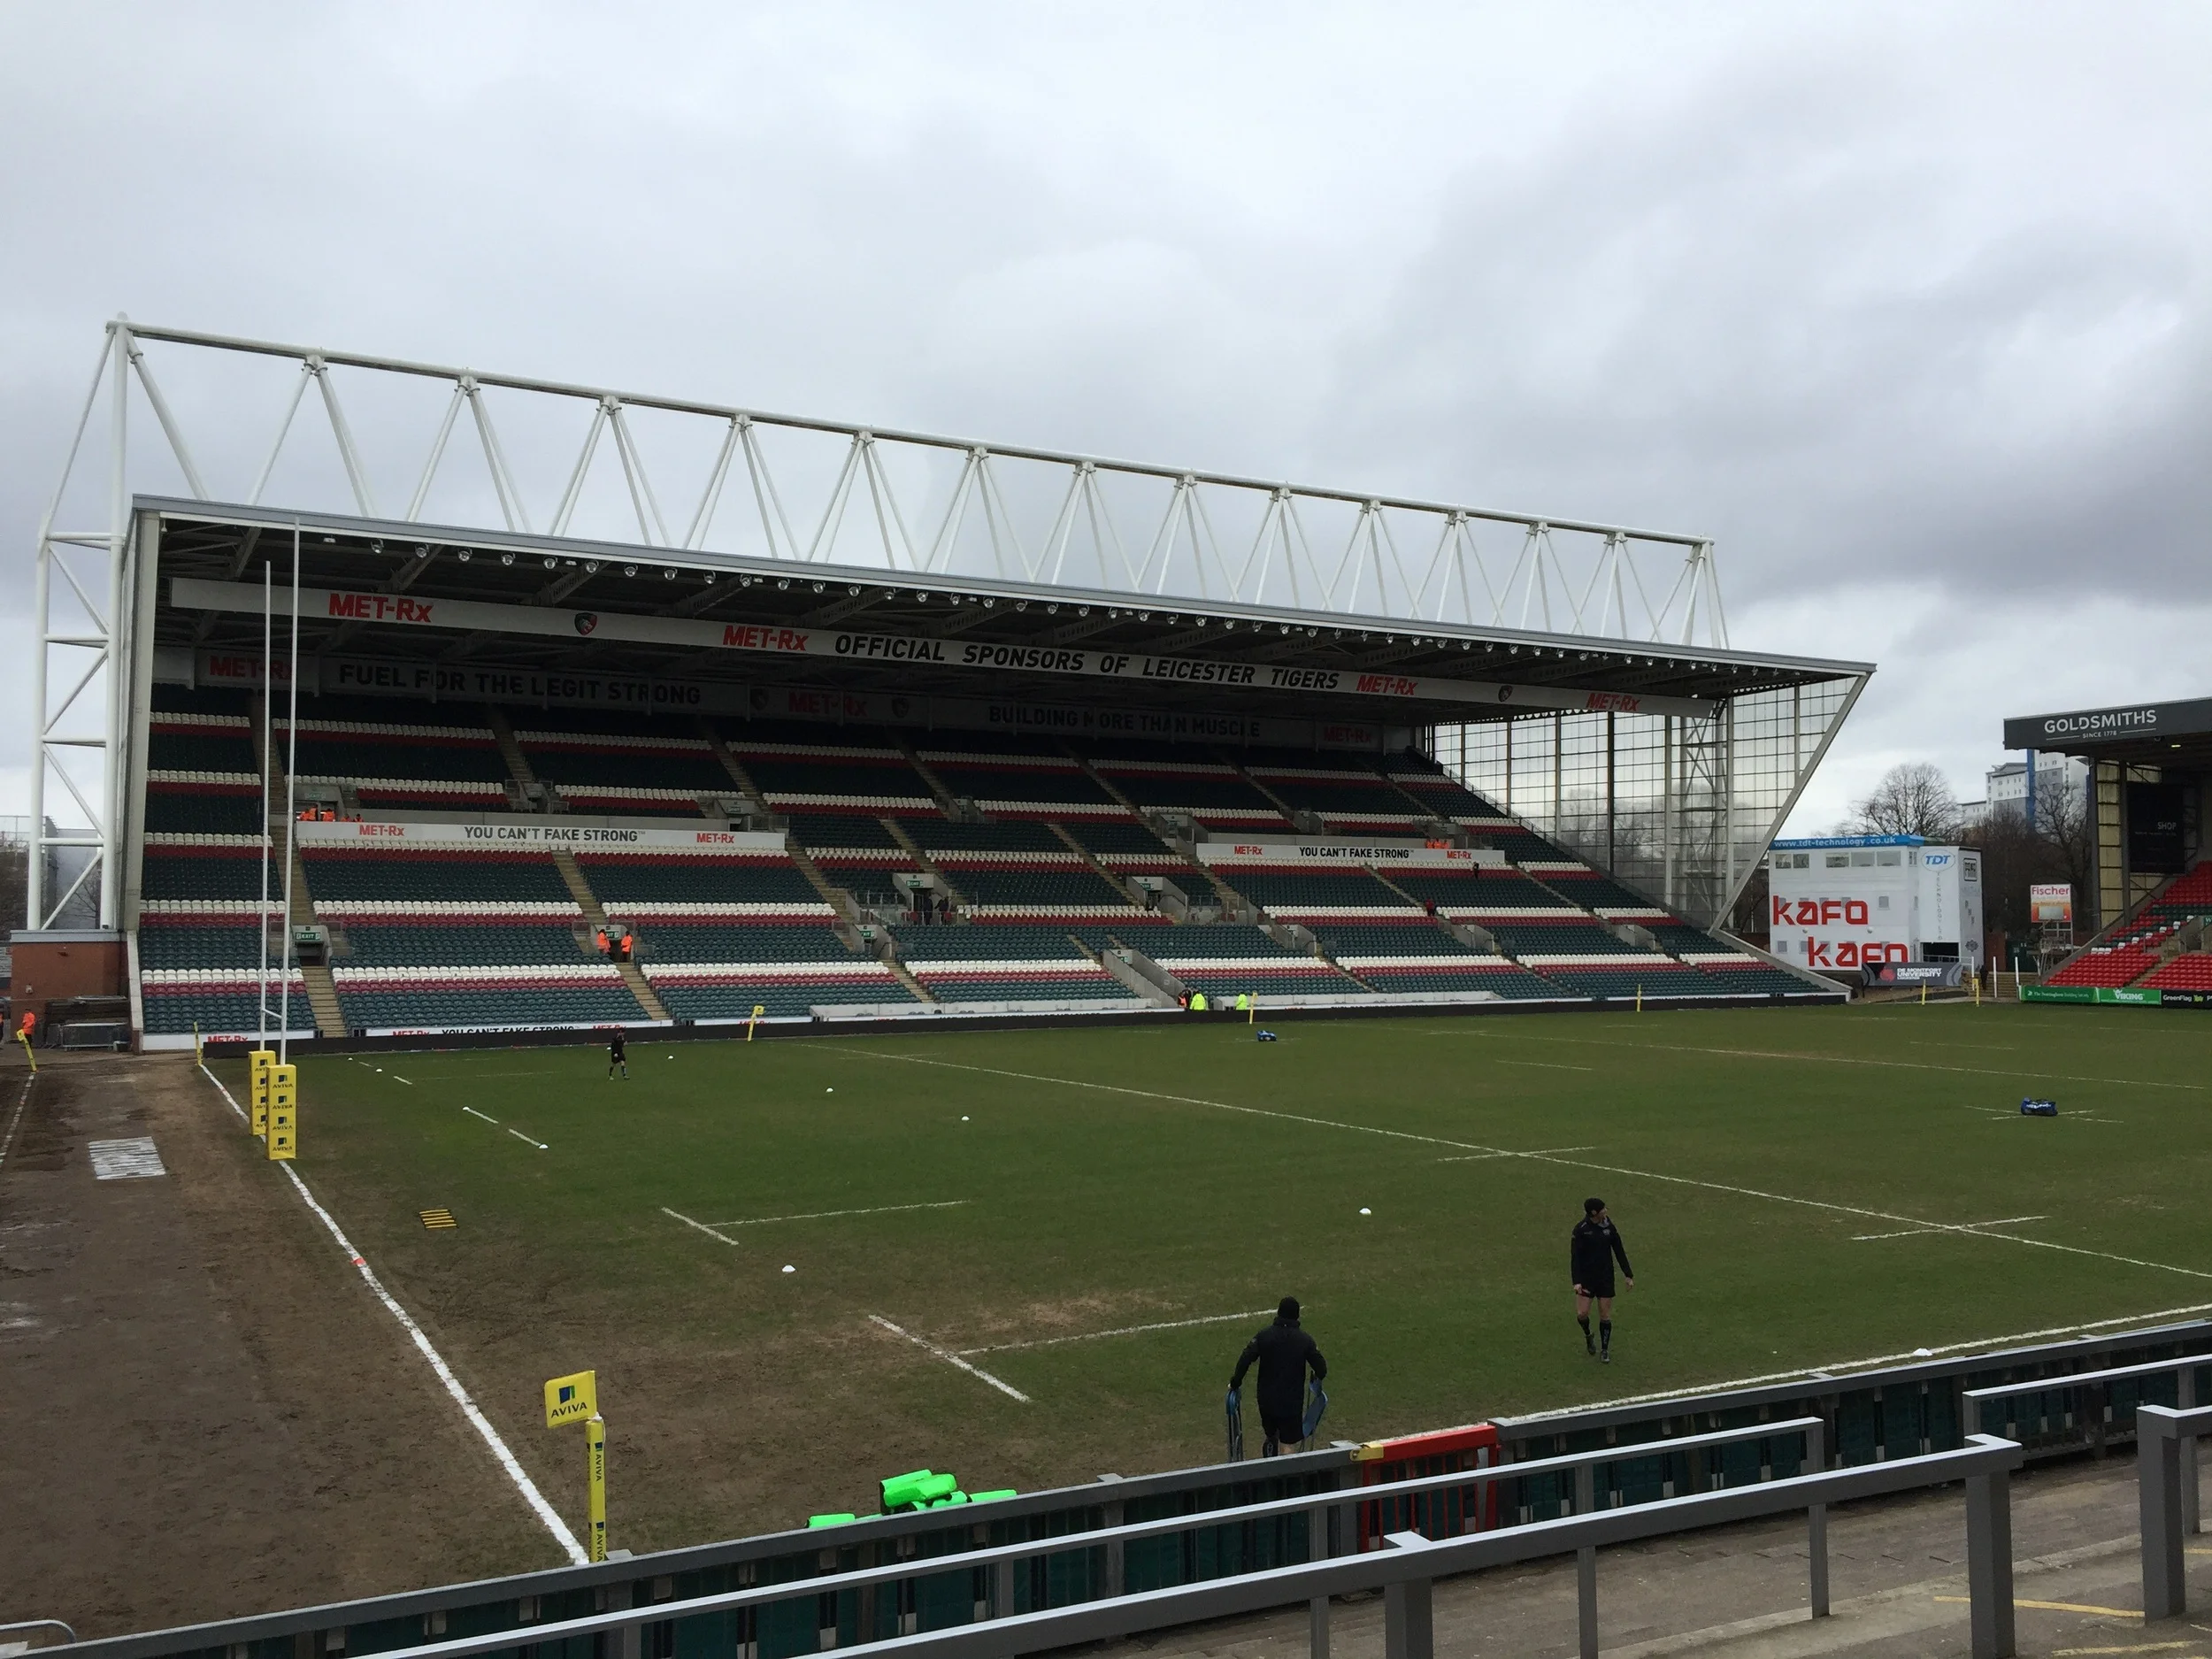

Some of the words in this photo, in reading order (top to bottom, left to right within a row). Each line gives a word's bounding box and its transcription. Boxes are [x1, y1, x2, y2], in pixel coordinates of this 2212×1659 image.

[329, 593, 434, 623] MET-Rx
[723, 625, 809, 651] MET-Rx
[835, 634, 945, 662] OFFICIAL
[963, 645, 1085, 672] SPONSORS
[1100, 655, 1129, 674] OF
[1142, 658, 1256, 684] LEICESTER
[1271, 668, 1340, 690] TIGERS
[339, 664, 406, 687] FUEL
[415, 669, 465, 692] FOR
[475, 672, 524, 695] THE
[532, 676, 601, 699] LEGIT
[608, 680, 701, 705] STRONG
[1356, 674, 1419, 696] MET-Rx
[1586, 693, 1640, 712] MET-Rx
[989, 705, 1079, 726] BUILDING
[1141, 715, 1187, 733] THAN
[1192, 717, 1260, 737] MUSCLE
[2044, 710, 2157, 733] GOLDSMITHS
[358, 824, 404, 837] MET-Rx
[465, 826, 495, 840] YOU
[497, 827, 541, 841] CAN'T
[544, 828, 580, 841] FAKE
[2157, 821, 2177, 831] SHOP
[696, 833, 734, 844] MET-Rx
[1234, 845, 1263, 856] MET-Rx
[1299, 847, 1317, 856] YOU
[1319, 847, 1348, 857] CAN'T
[1349, 848, 1372, 858] FAKE
[1447, 850, 1471, 859] MET-Rx
[1925, 855, 1950, 865] TDT
[2114, 992, 2143, 1001] VIKING
[550, 1402, 588, 1419] AVIVA
